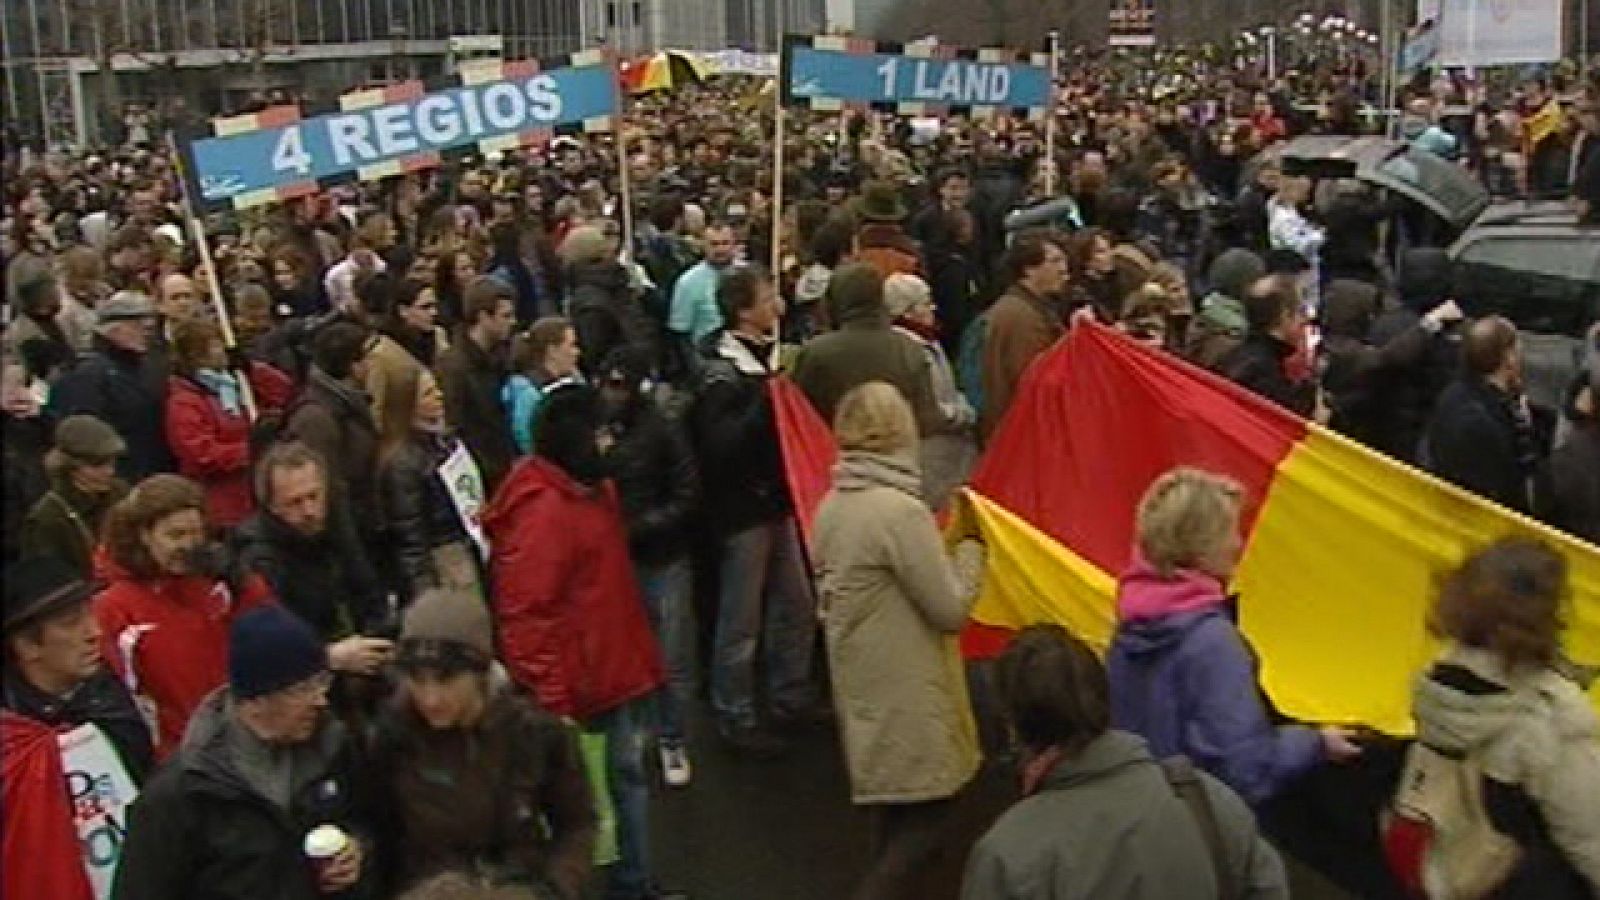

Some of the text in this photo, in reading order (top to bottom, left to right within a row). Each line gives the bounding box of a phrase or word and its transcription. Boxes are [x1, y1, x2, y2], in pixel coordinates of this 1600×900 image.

[877, 57, 1011, 101] 1 LAND
[272, 75, 562, 174] 4 REGIOS
